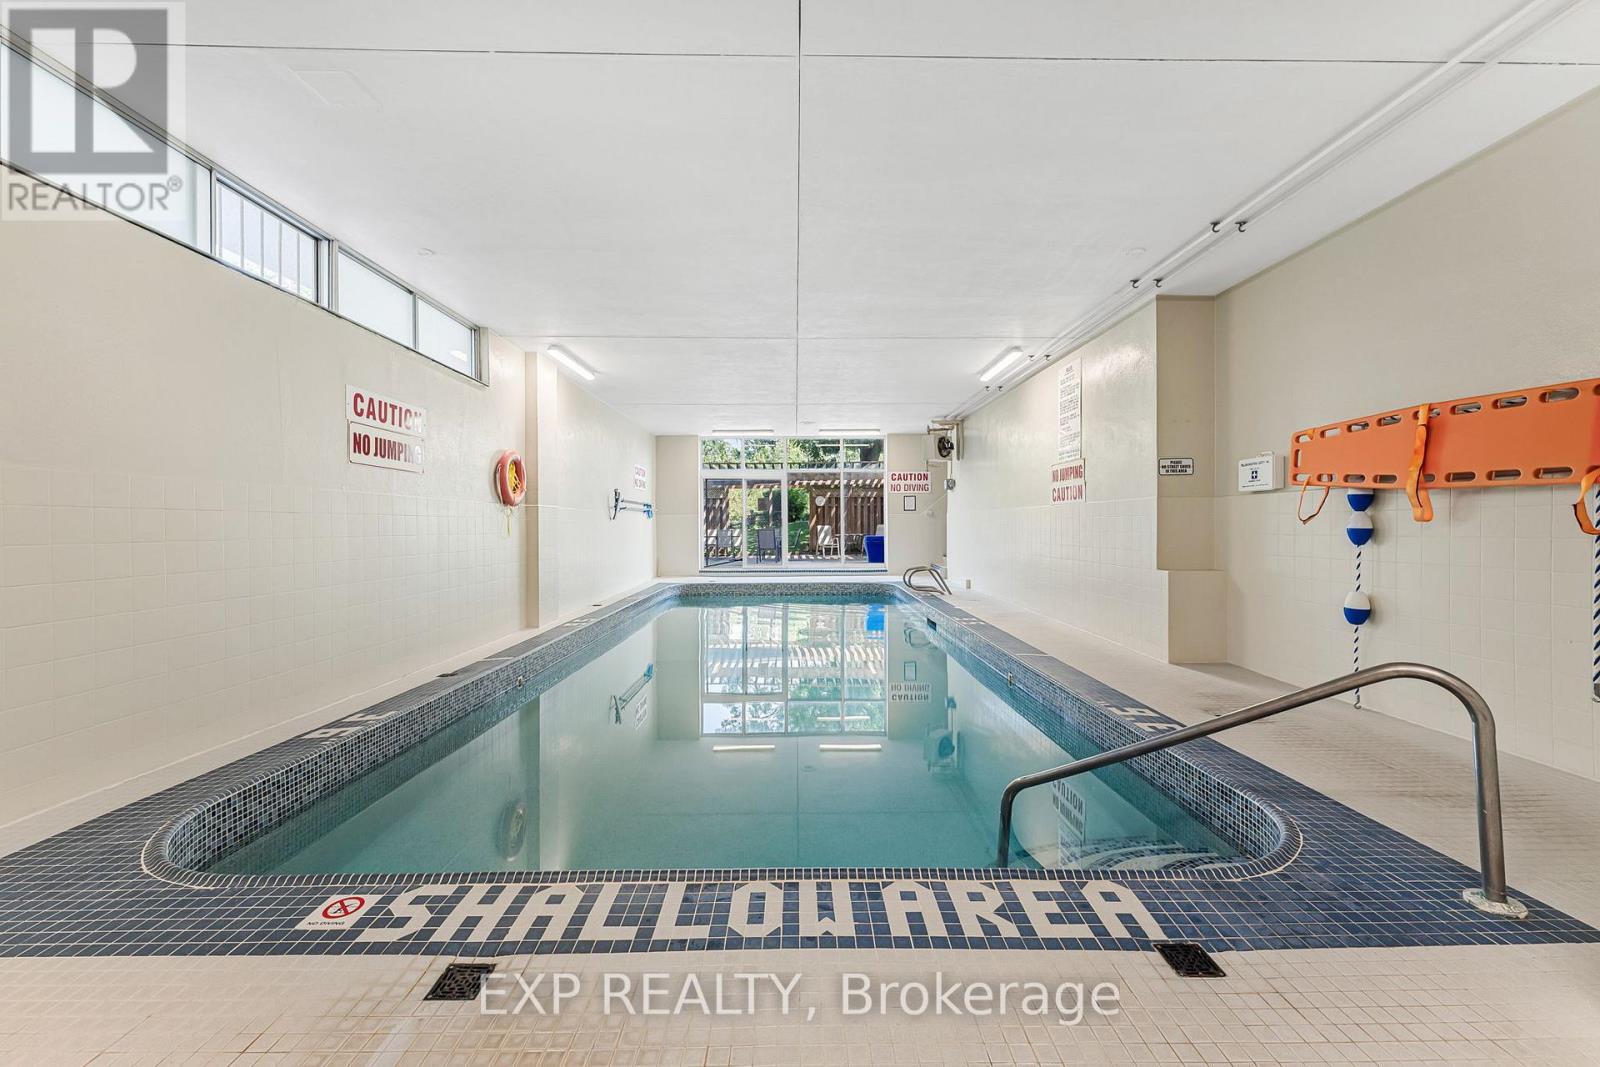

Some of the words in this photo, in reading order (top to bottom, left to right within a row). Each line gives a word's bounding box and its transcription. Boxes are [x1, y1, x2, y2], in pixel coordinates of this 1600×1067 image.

[353, 392, 422, 431] CAUTION
[353, 432, 371, 456] NO
[374, 437, 422, 464] JUMPING
[891, 473, 929, 481] CAUTION
[1052, 468, 1060, 482] NO
[1060, 465, 1083, 481] JUMPING
[890, 483, 902, 492] NO
[904, 483, 930, 492] DIVING
[1052, 484, 1083, 502] CAUTION
[358, 881, 857, 942] SHALLOW
[881, 880, 1167, 939] AREA
